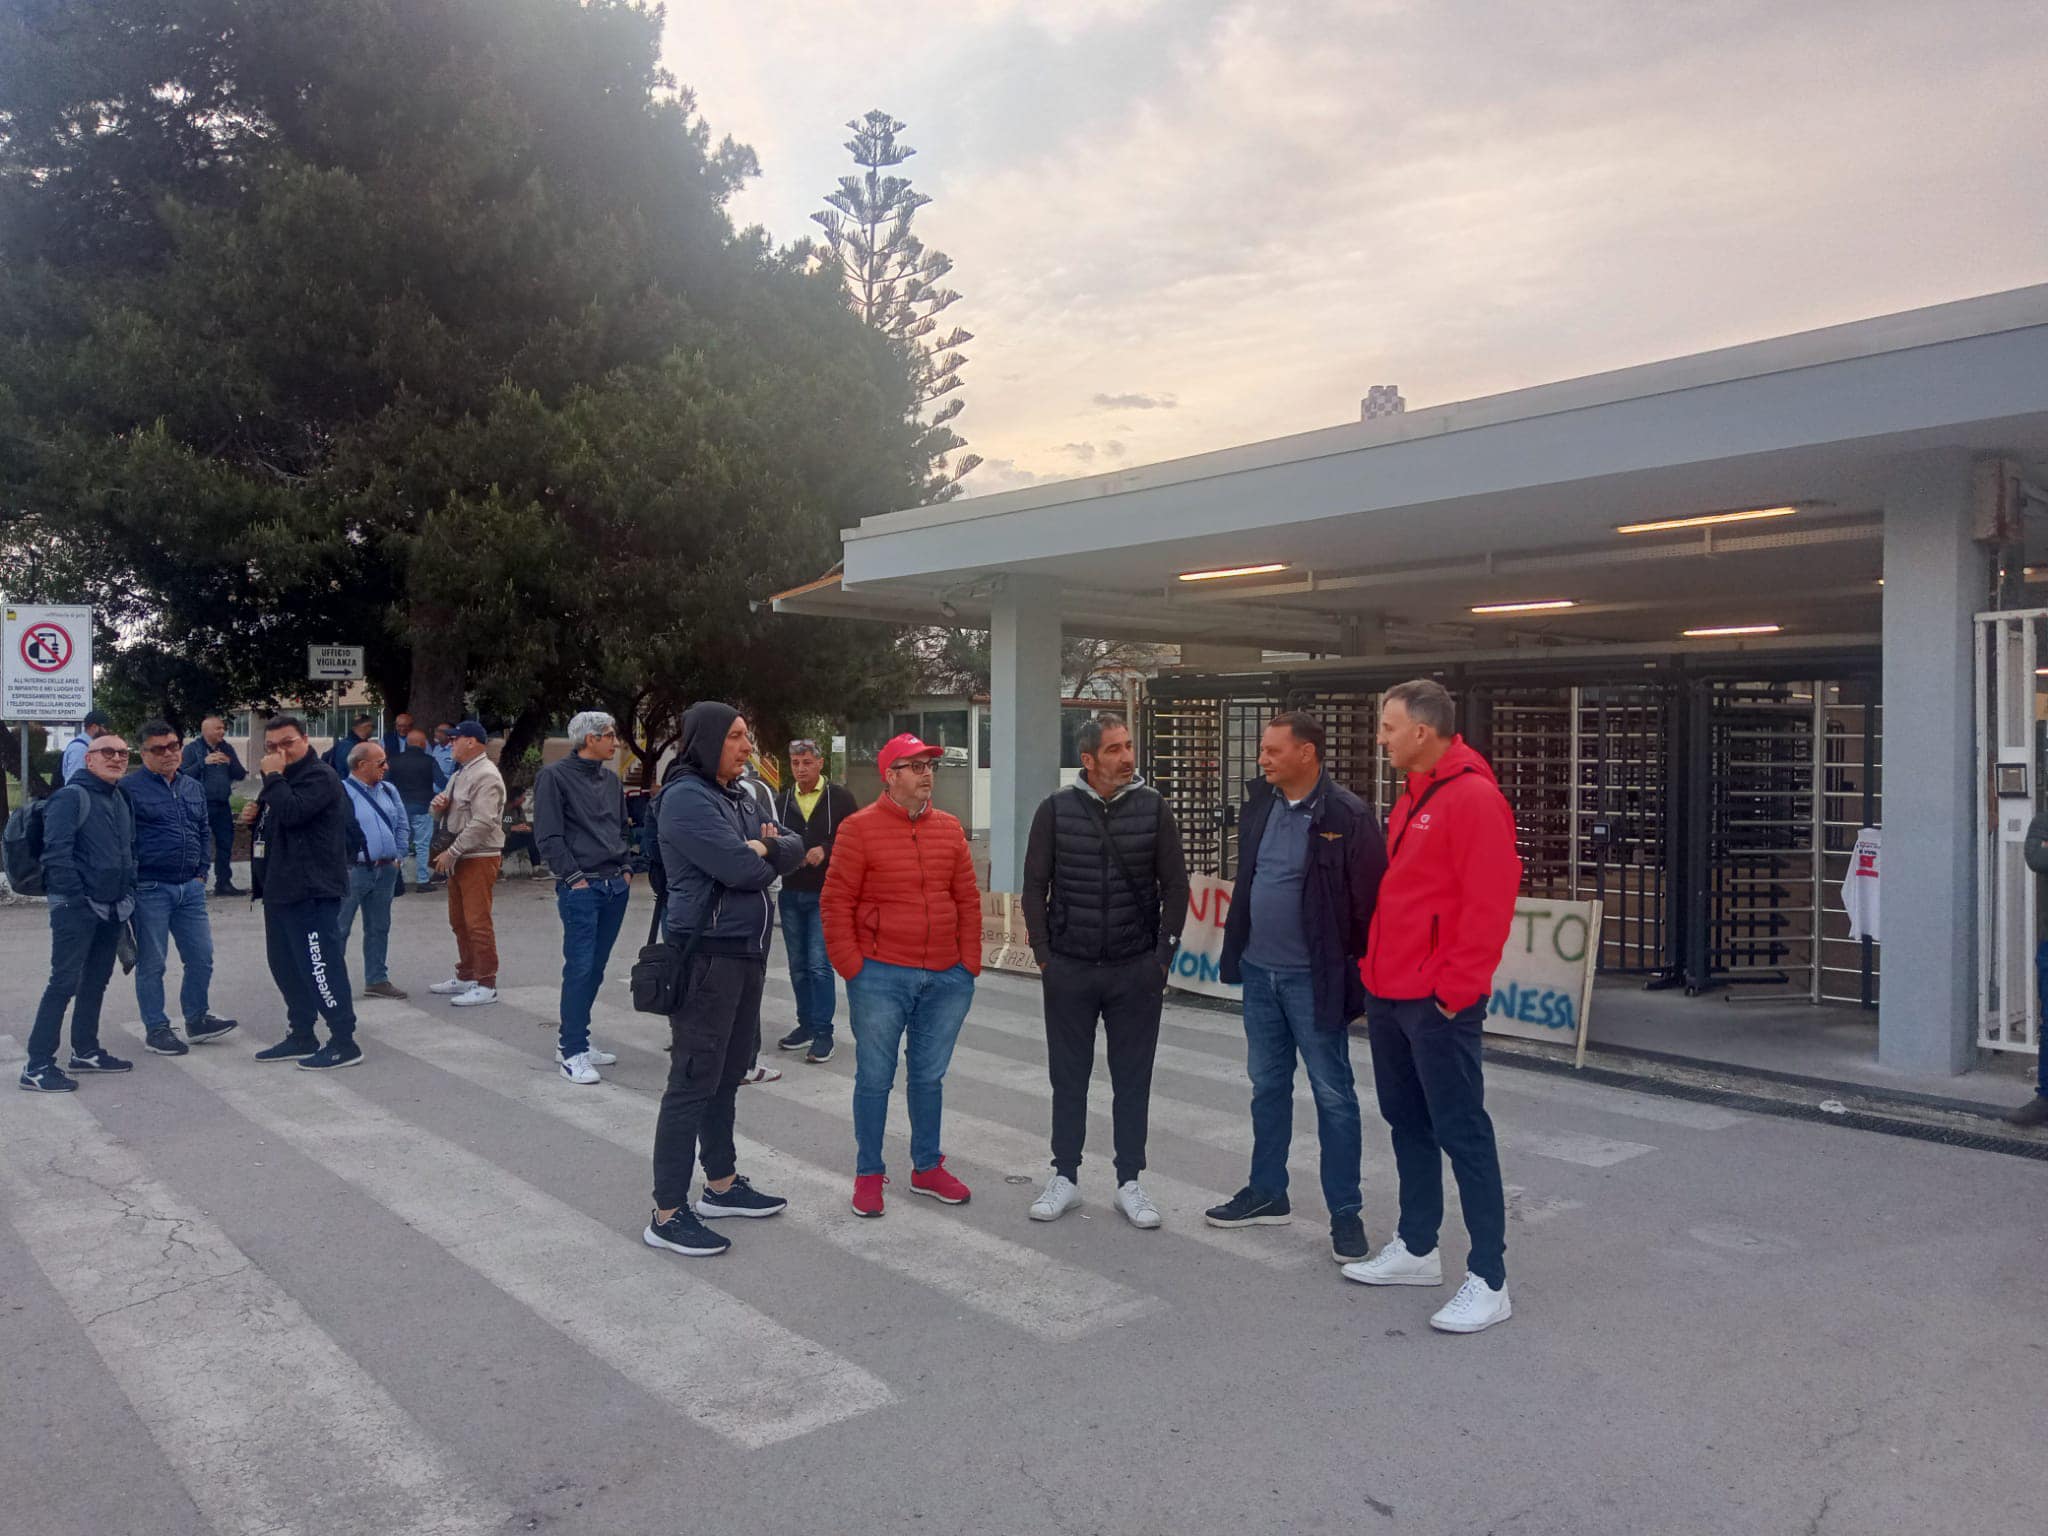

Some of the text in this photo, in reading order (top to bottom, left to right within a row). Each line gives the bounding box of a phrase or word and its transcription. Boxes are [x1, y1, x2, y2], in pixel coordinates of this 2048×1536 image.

[321, 648, 351, 657] UFFICIO
[316, 657, 357, 666] VIGILANZA
[308, 931, 337, 1008] sweetyears
